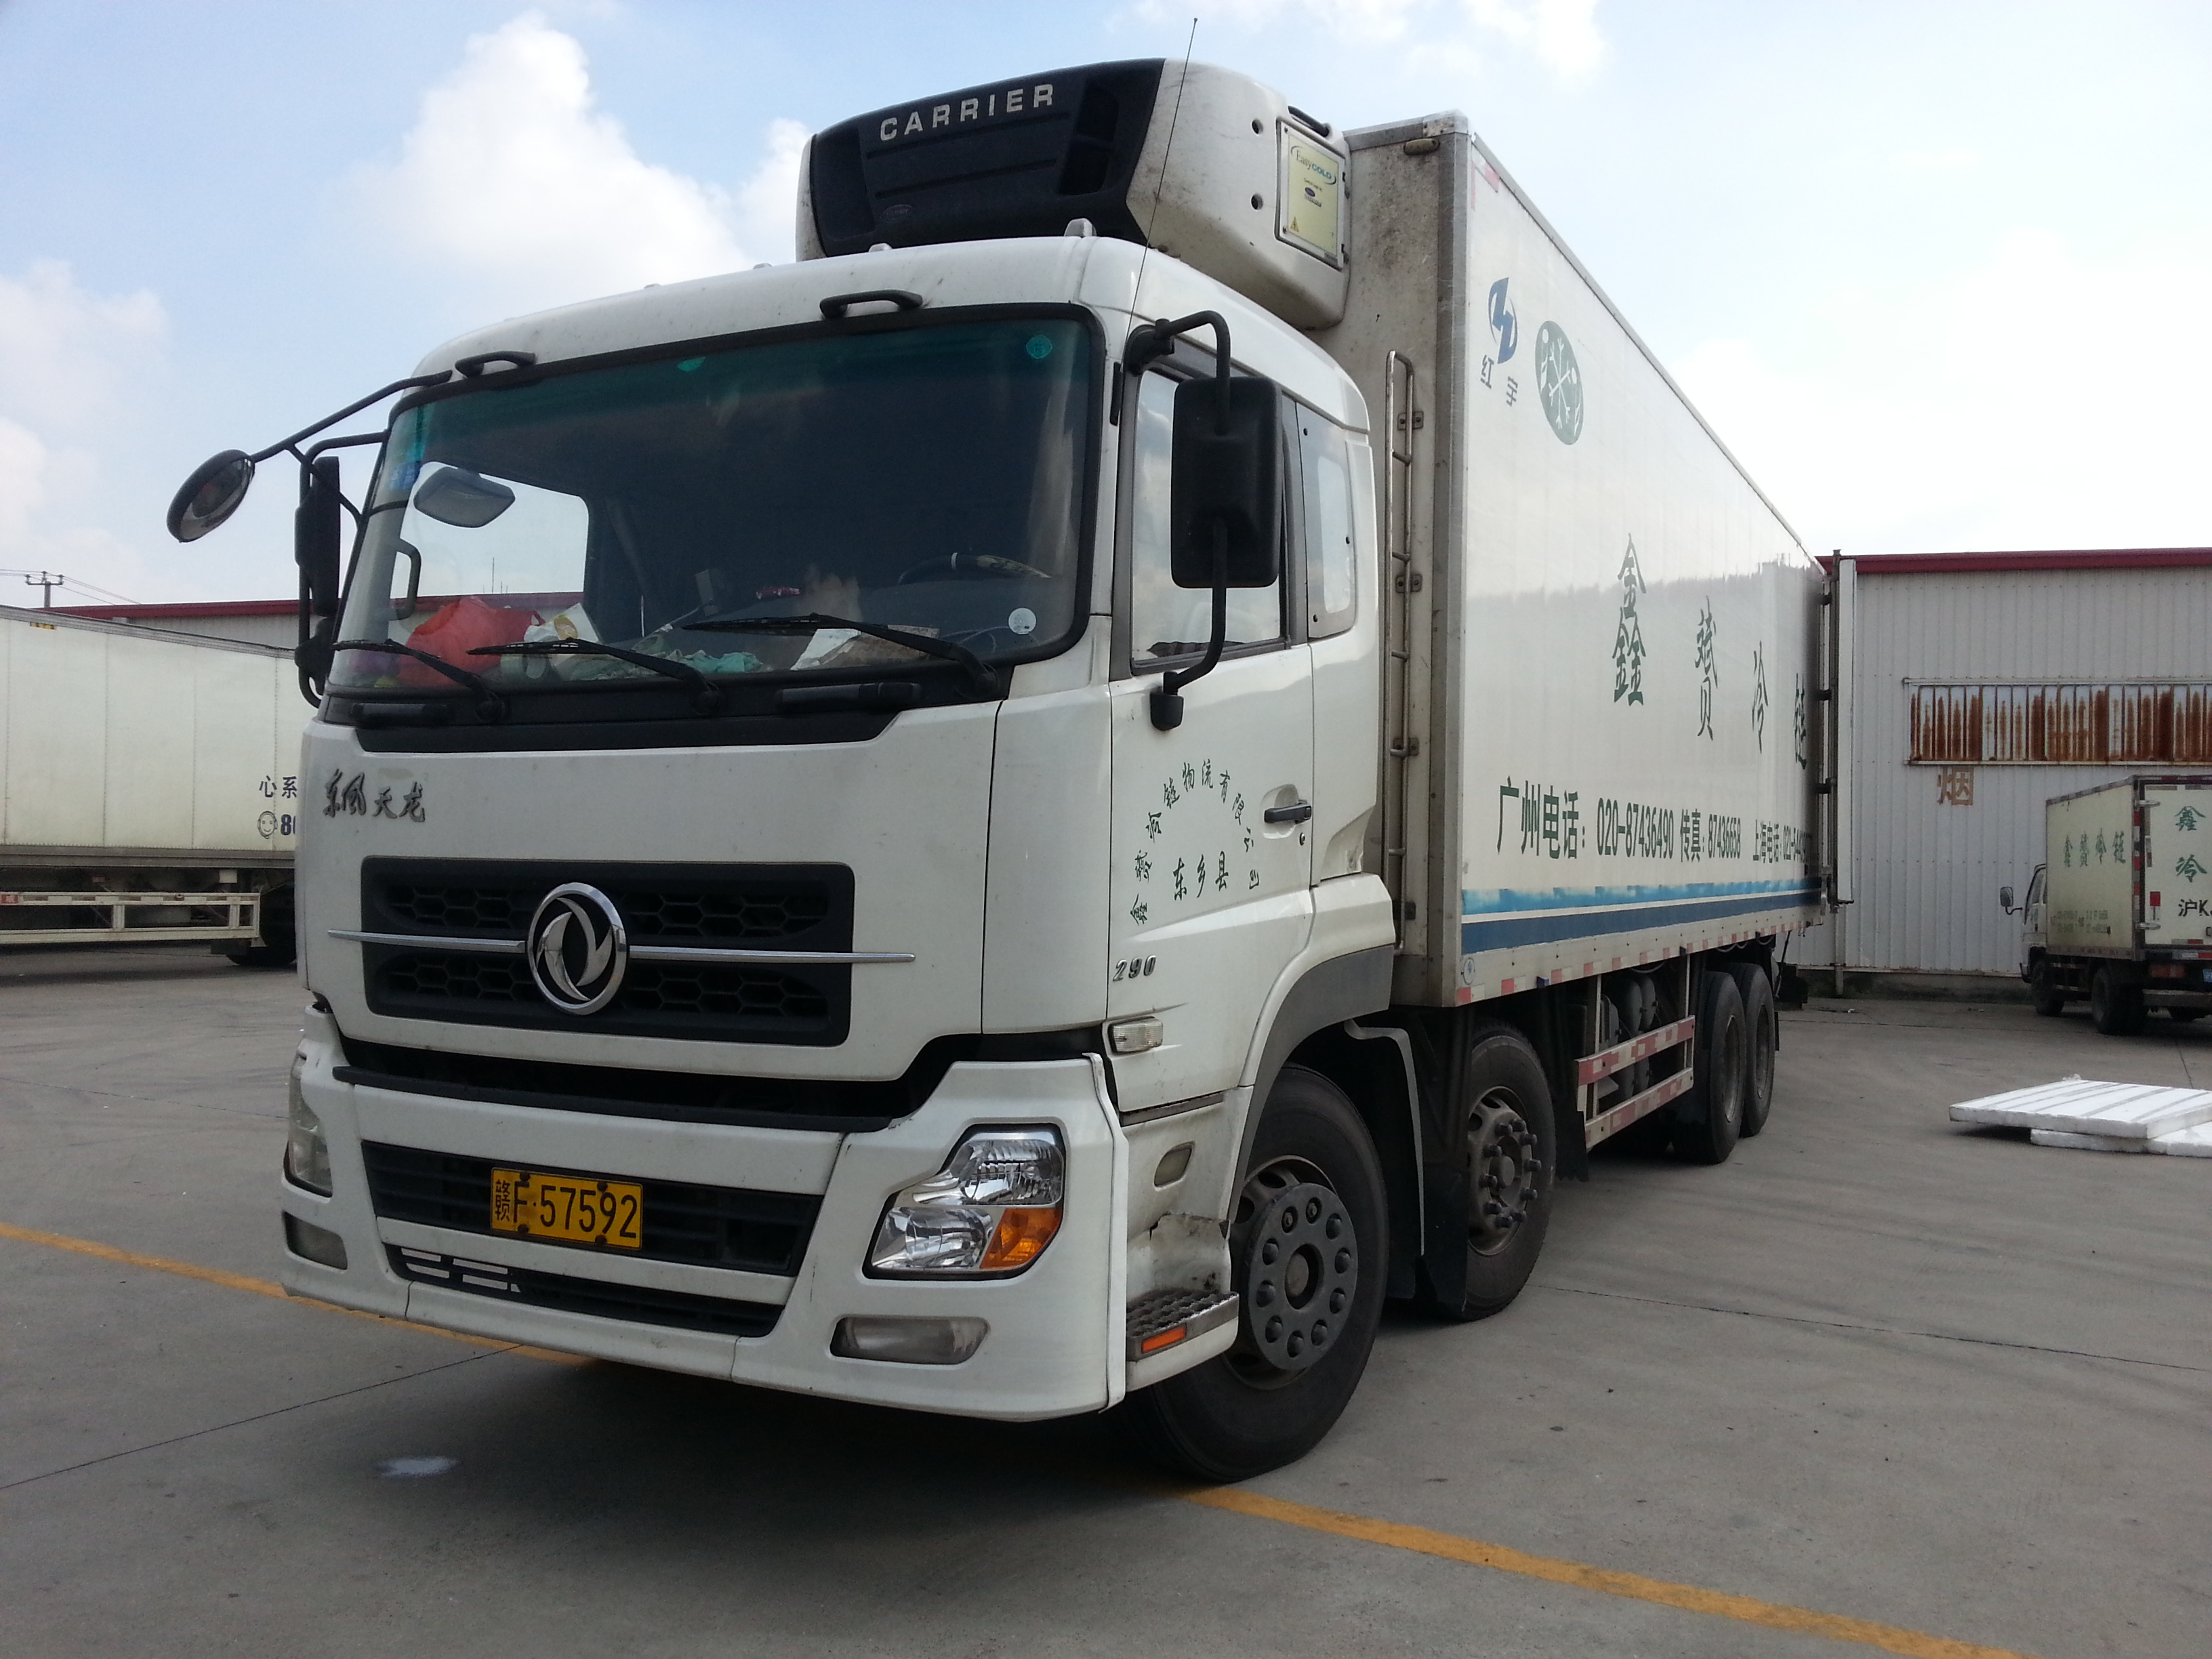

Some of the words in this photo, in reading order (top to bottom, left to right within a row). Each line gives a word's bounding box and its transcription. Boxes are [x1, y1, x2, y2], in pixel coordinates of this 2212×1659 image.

[880, 83, 1053, 141] CARRIER
[1937, 765, 1974, 805] 烟
[1172, 851, 1229, 901] 东乡县
[2178, 899, 2212, 916] 沪K
[1112, 954, 1157, 982] 290
